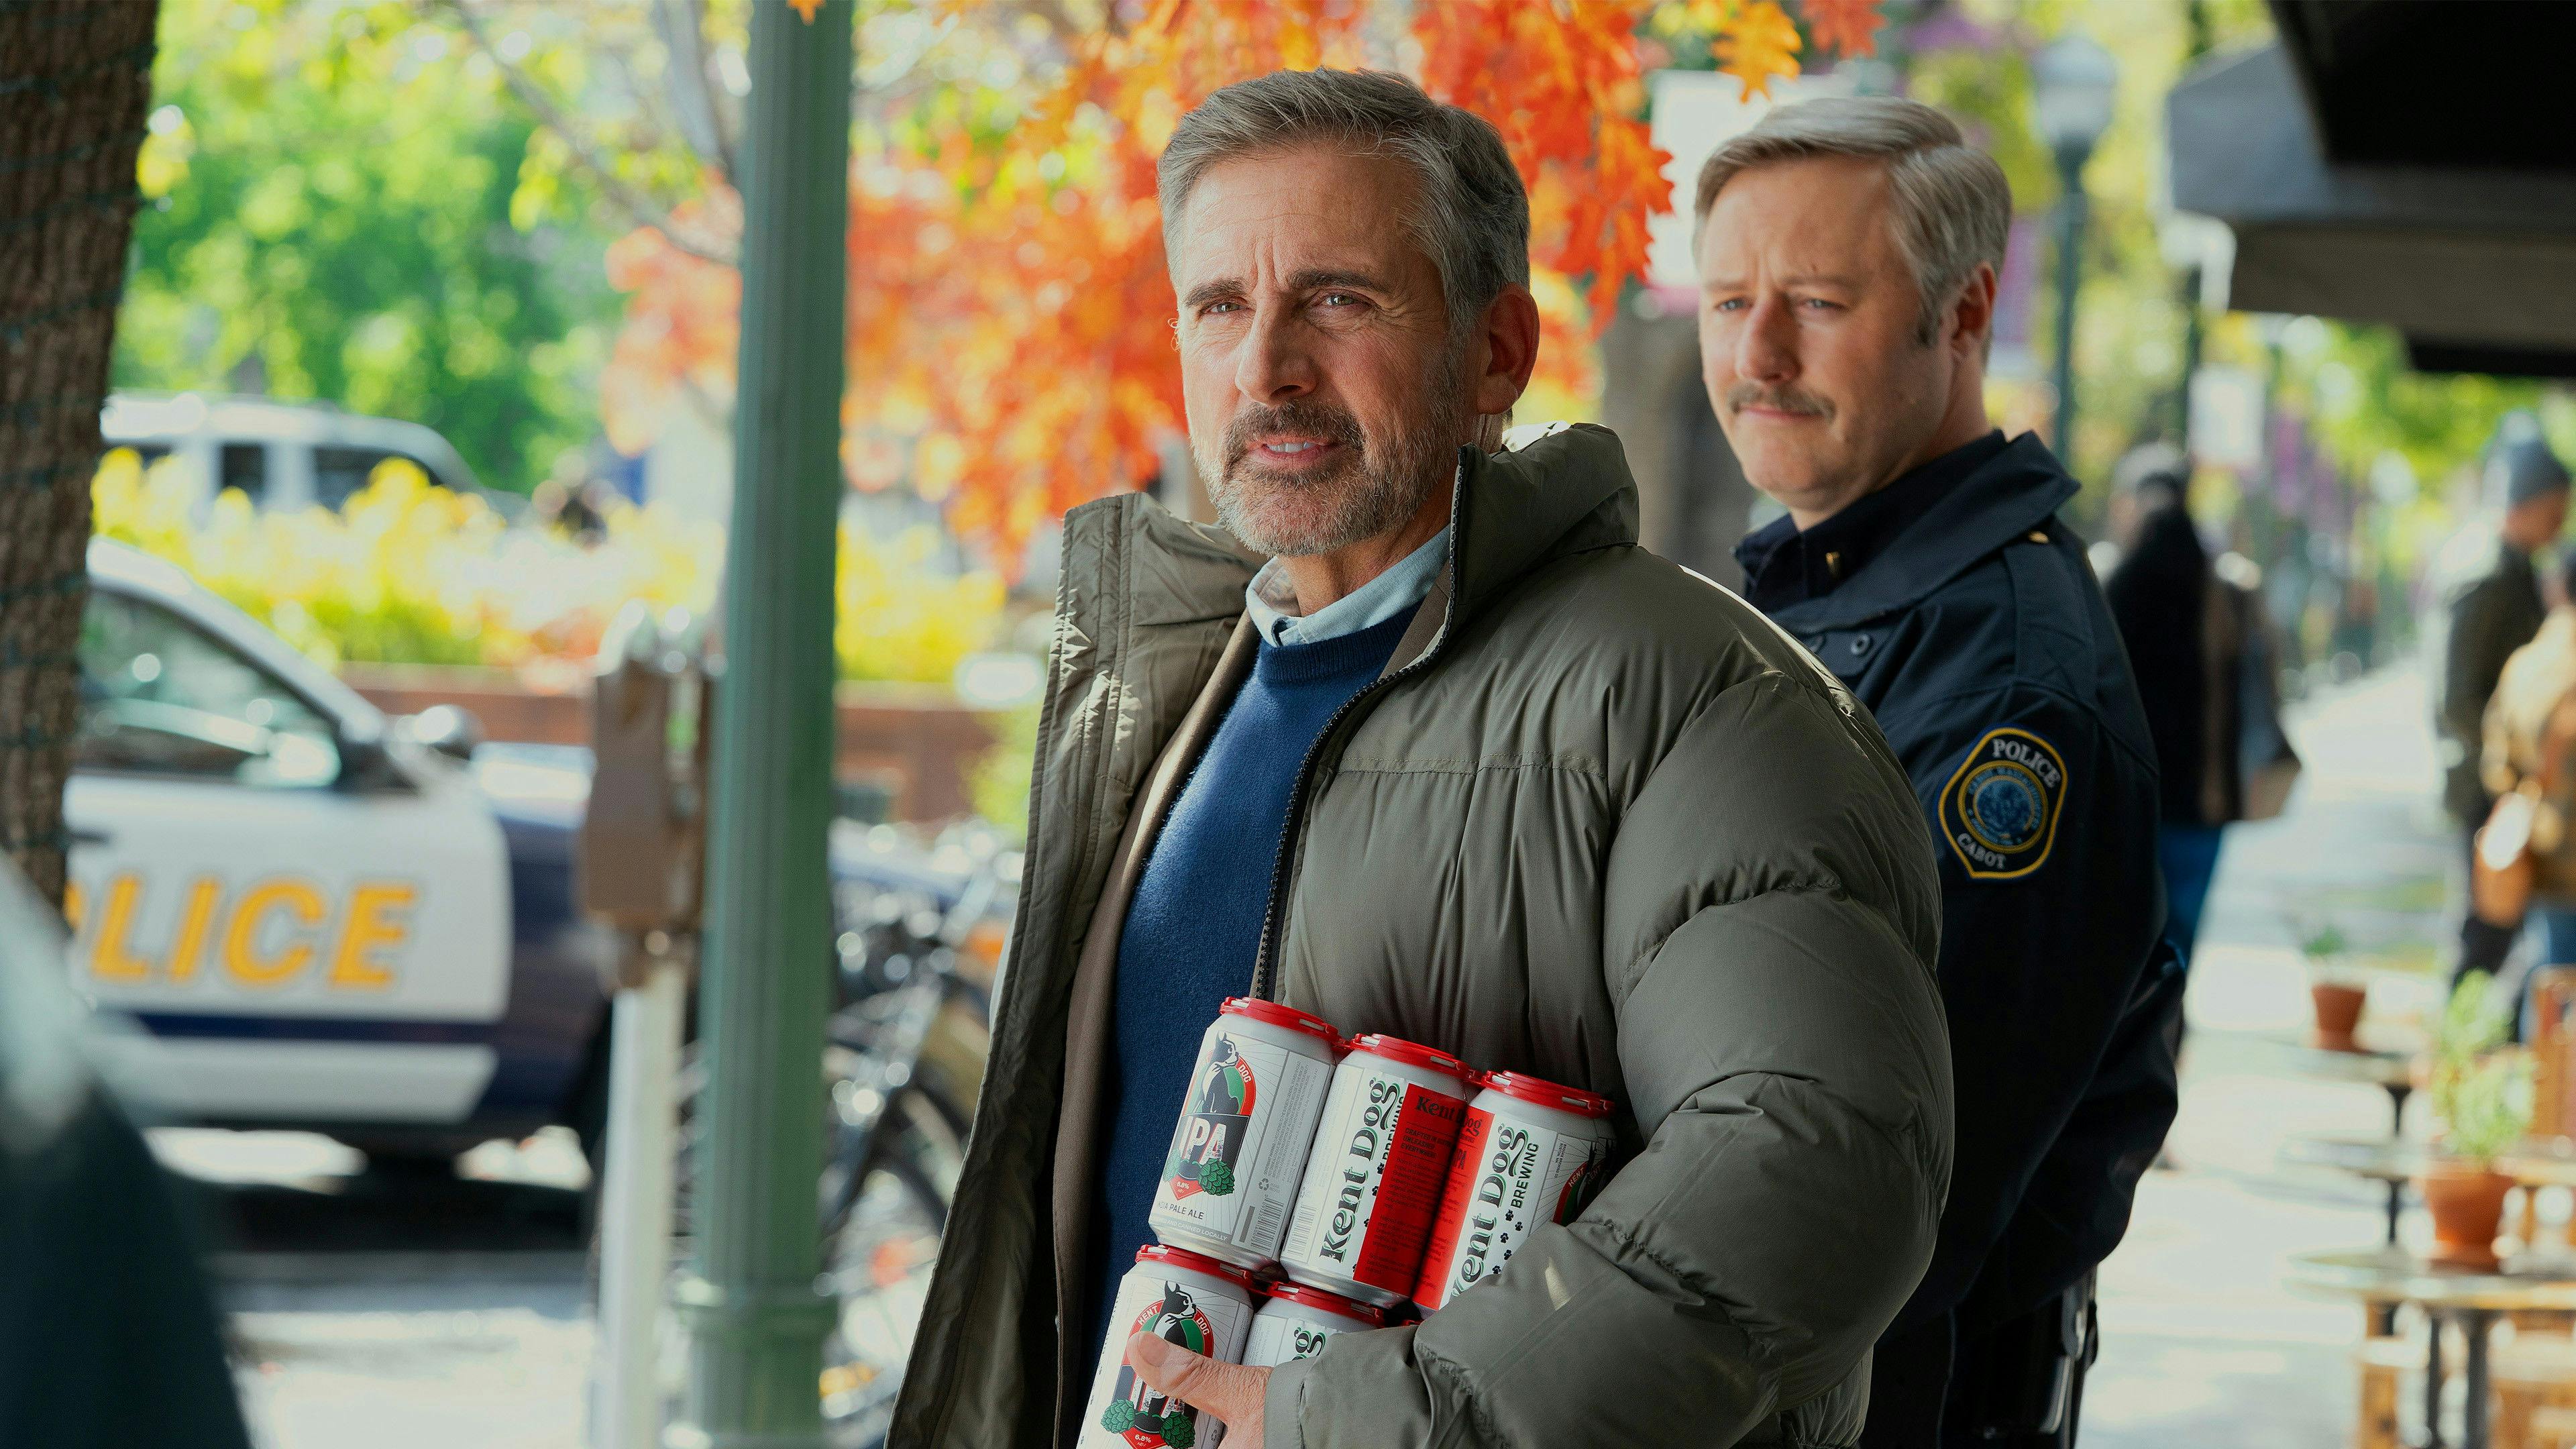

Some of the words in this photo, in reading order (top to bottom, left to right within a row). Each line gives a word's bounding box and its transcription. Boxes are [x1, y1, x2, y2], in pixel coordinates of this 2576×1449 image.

[1992, 739, 2061, 788] POLICE
[1957, 833, 2006, 869] CABOT
[64, 875, 417, 987] LICE
[1238, 1065, 1252, 1083] DOG
[1415, 1095, 1455, 1121] Kent
[1179, 1115, 1226, 1166] IPA
[1319, 1167, 1368, 1264] Kent
[1349, 1077, 1400, 1161] Dog
[1478, 1124, 1529, 1208] Dog
[1511, 1142, 1539, 1209] BREWING
[1568, 1167, 1584, 1187] KENT
[1177, 1181, 1189, 1189] 6.8%
[1169, 1203, 1187, 1215] PALE
[1188, 1210, 1204, 1220] ALE
[1177, 1221, 1201, 1233] CANNED
[1201, 1228, 1228, 1241] LOCALLY
[1137, 1305, 1158, 1326] KENT
[1196, 1317, 1210, 1336] DOG
[1135, 1434, 1151, 1443] 6.8%
